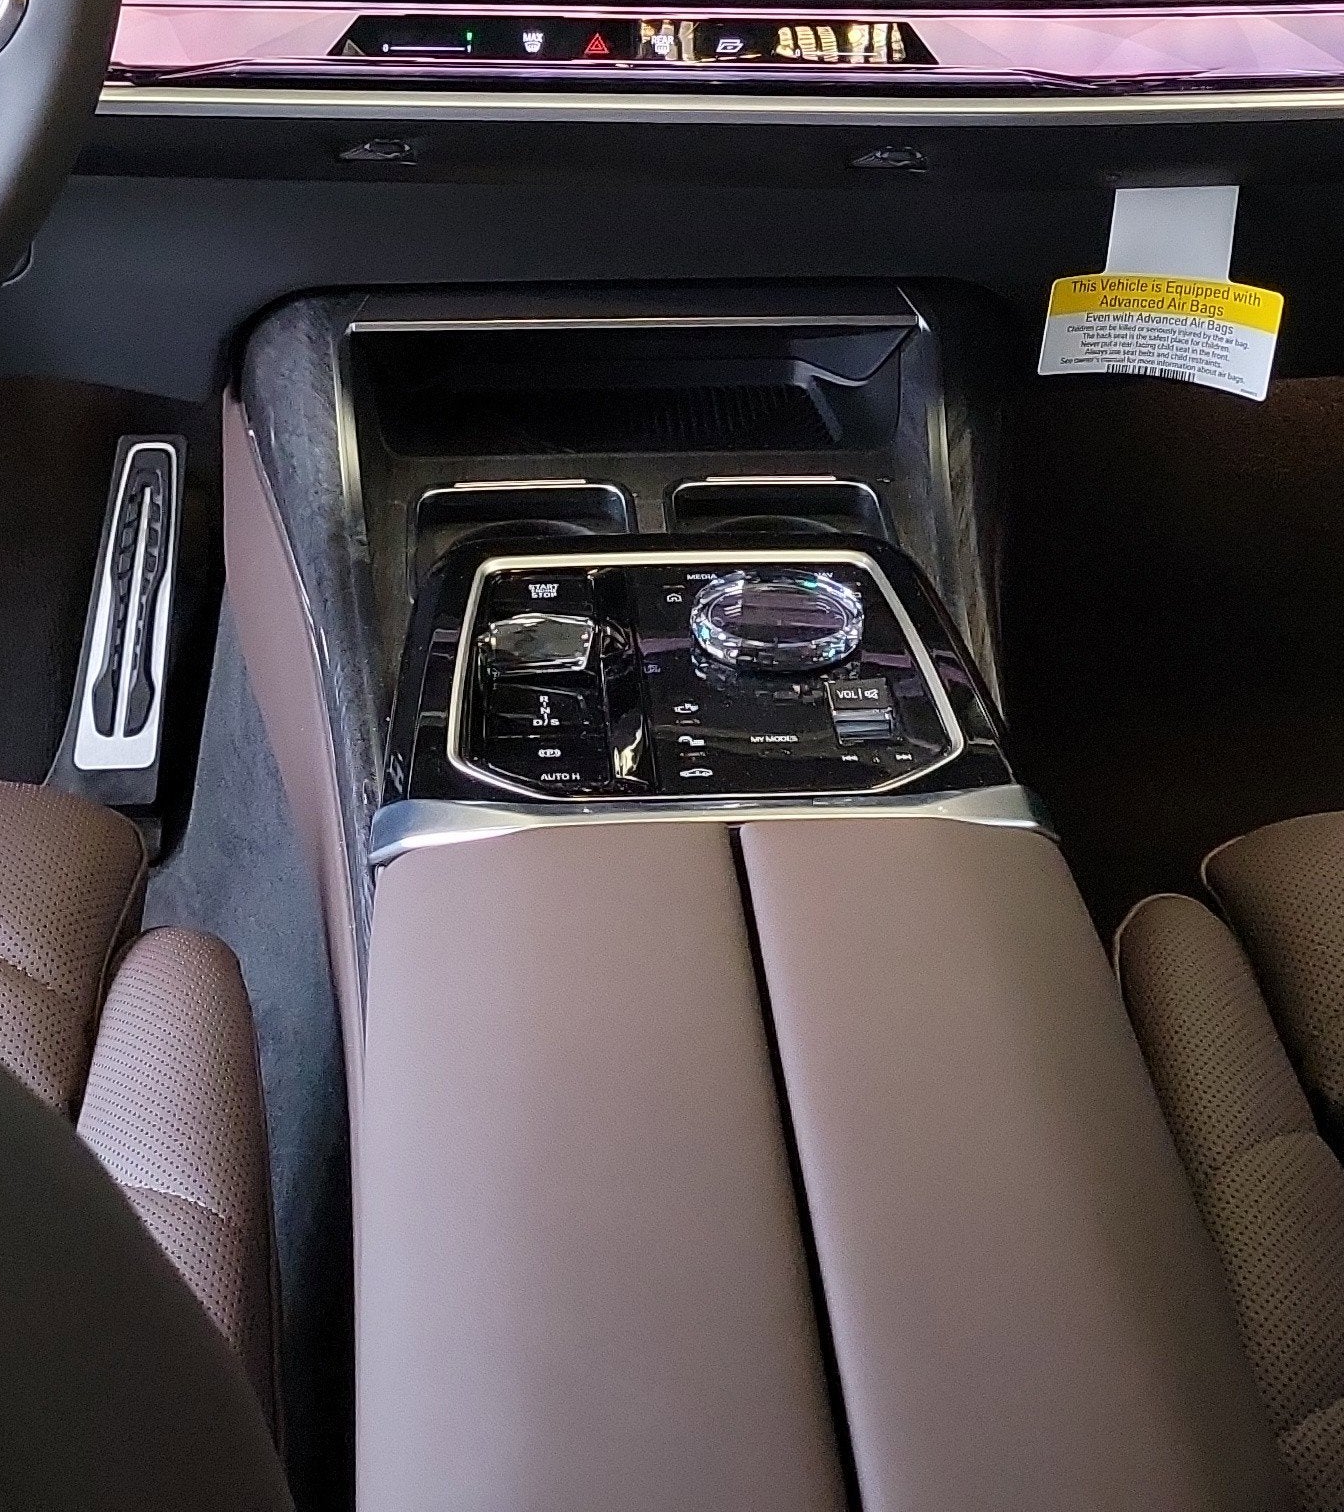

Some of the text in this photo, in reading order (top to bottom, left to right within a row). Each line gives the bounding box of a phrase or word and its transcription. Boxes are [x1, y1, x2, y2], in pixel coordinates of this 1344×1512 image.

[523, 32, 544, 42] MAX
[1072, 278, 1261, 307] This Vehicle is Equipped with
[1099, 294, 1224, 318] Advanced Air Bags
[1086, 313, 1234, 336] Even with Advanced Air Bags
[686, 572, 718, 581] MEDIA
[836, 690, 858, 699] VOL
[540, 773, 570, 781] AUTO
